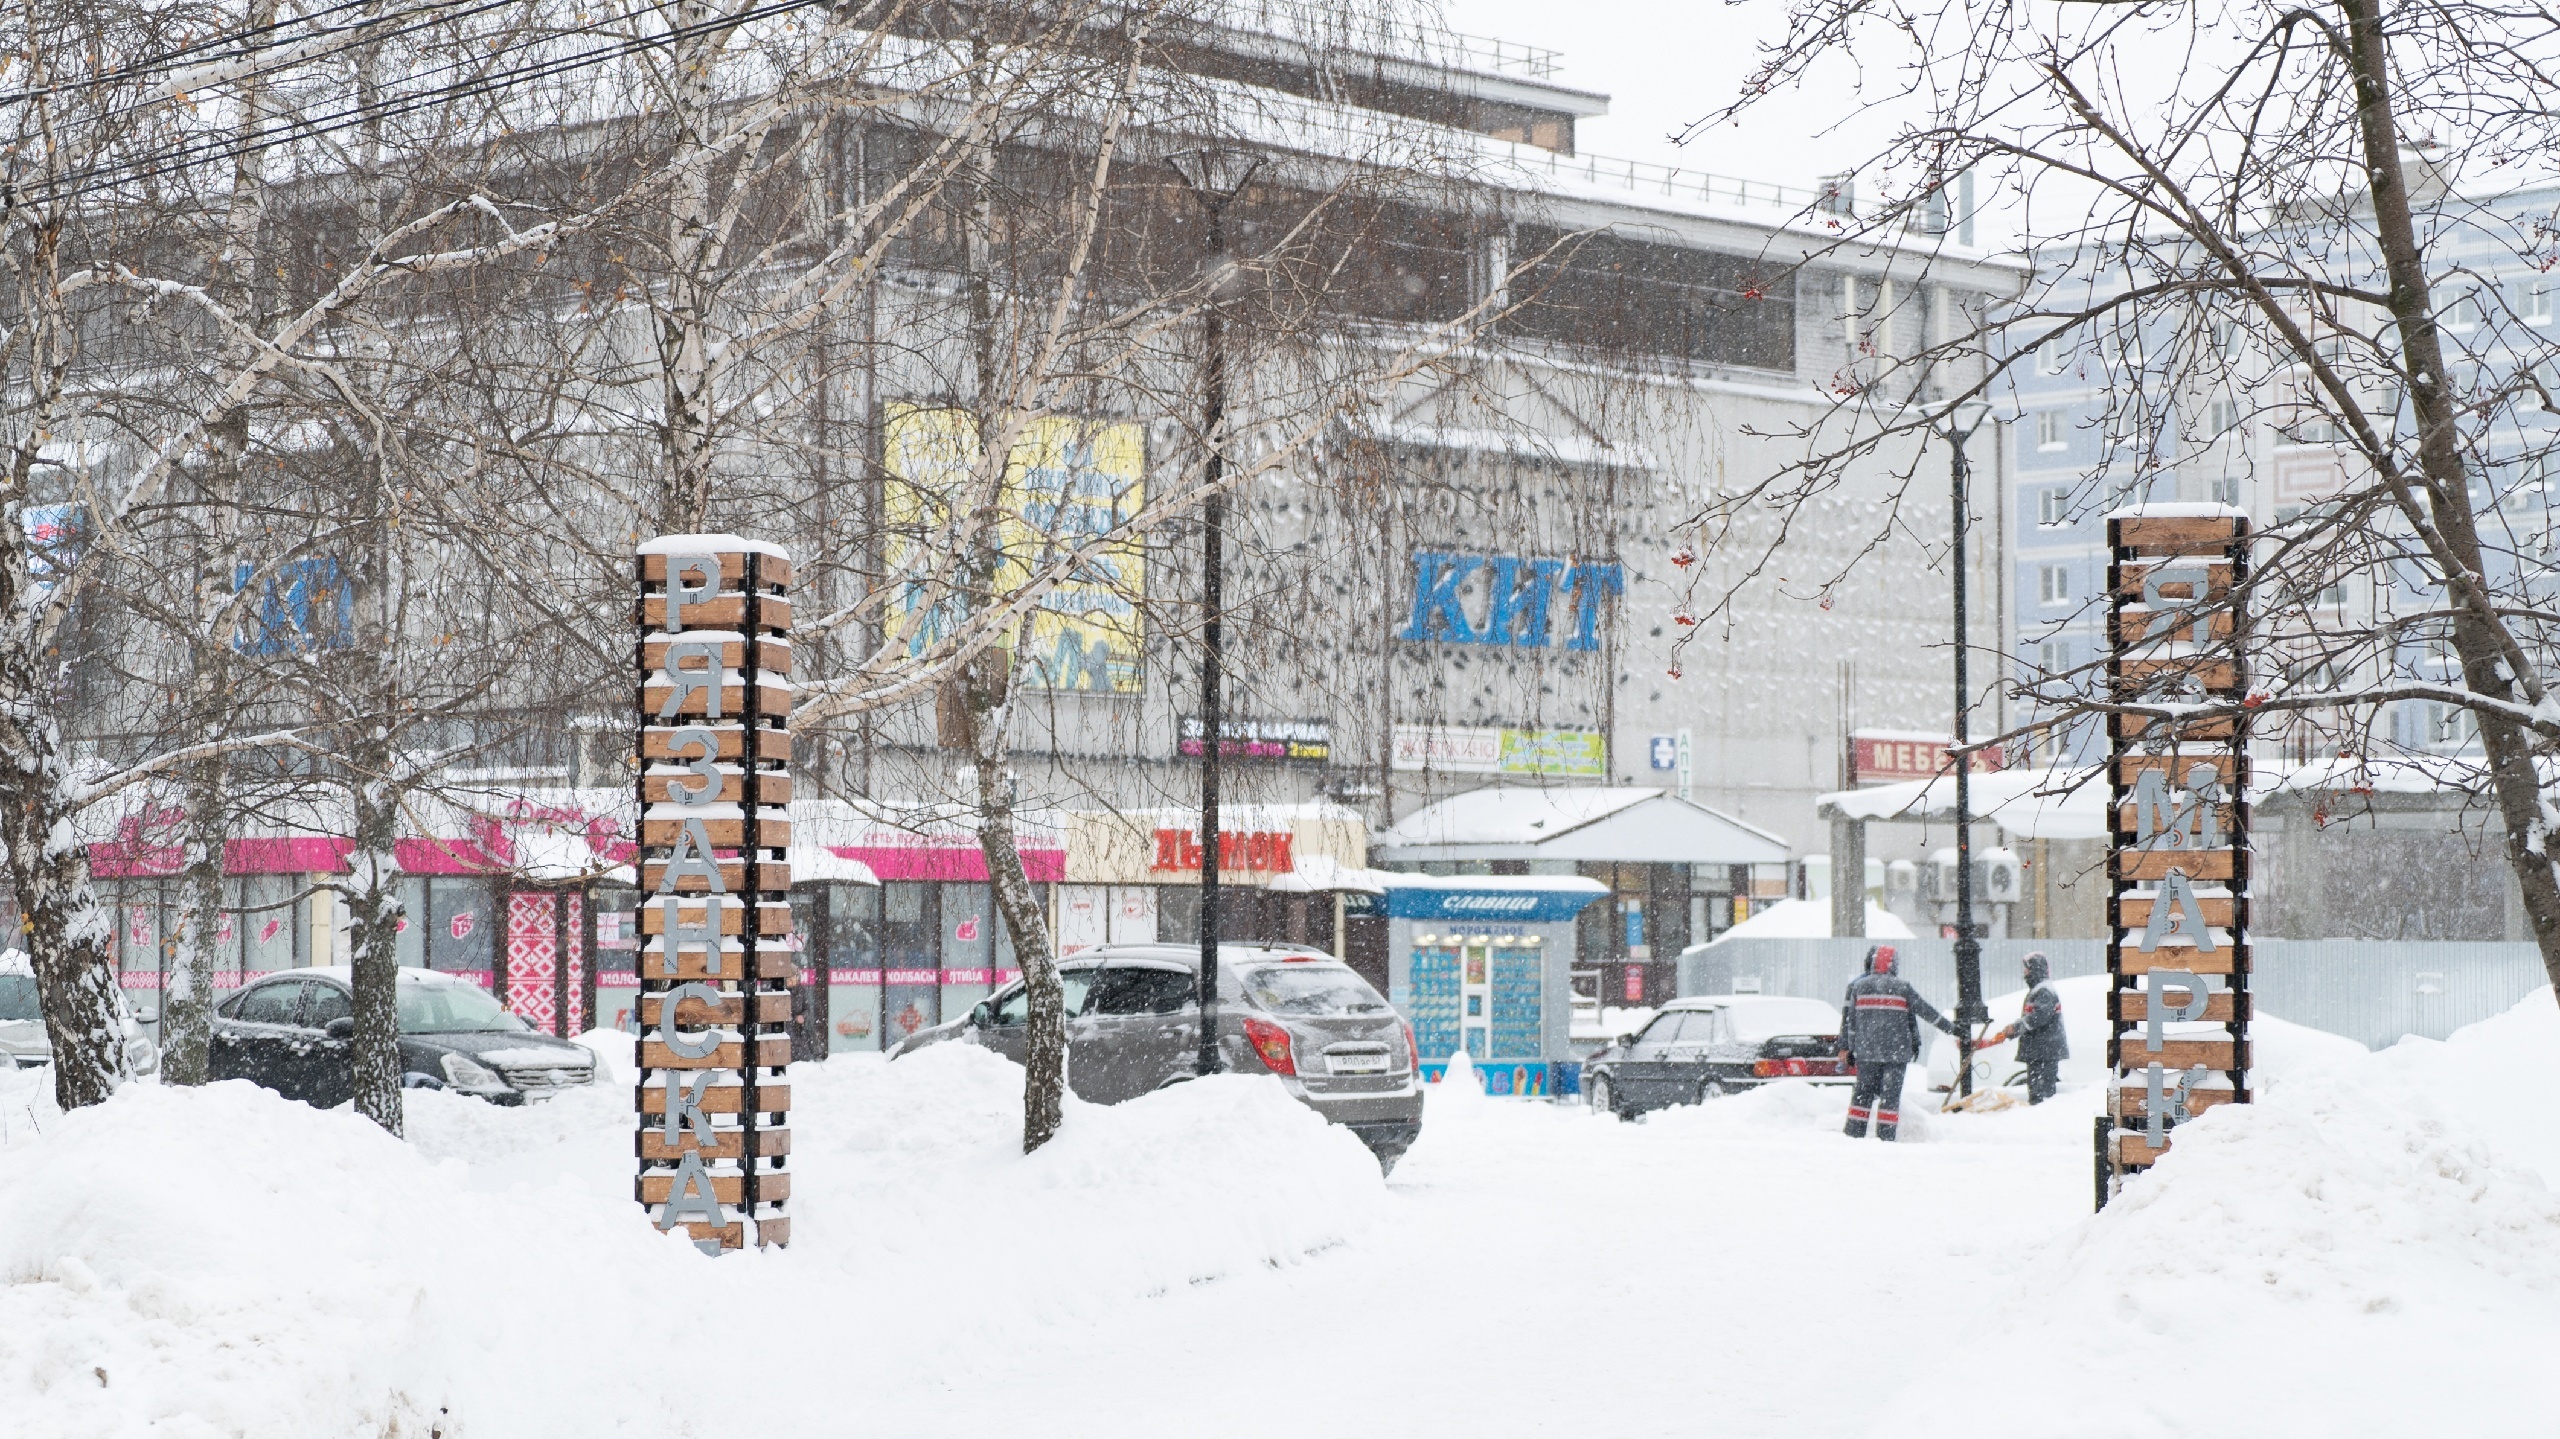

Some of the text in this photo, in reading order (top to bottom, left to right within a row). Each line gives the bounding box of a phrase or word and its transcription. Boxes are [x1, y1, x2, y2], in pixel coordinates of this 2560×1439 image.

[1396, 550, 1625, 652] КИТ
[1873, 743, 1987, 773] МЕБЕЬ
[658, 556, 727, 1257] РЯЗАНСКА
[1448, 925, 1525, 936] МОРОЖЕНОЕ
[830, 970, 879, 982] БАКАЛЕЯ
[886, 970, 937, 982] КОЛБАСЫ
[948, 970, 983, 983] ПТИЦА
